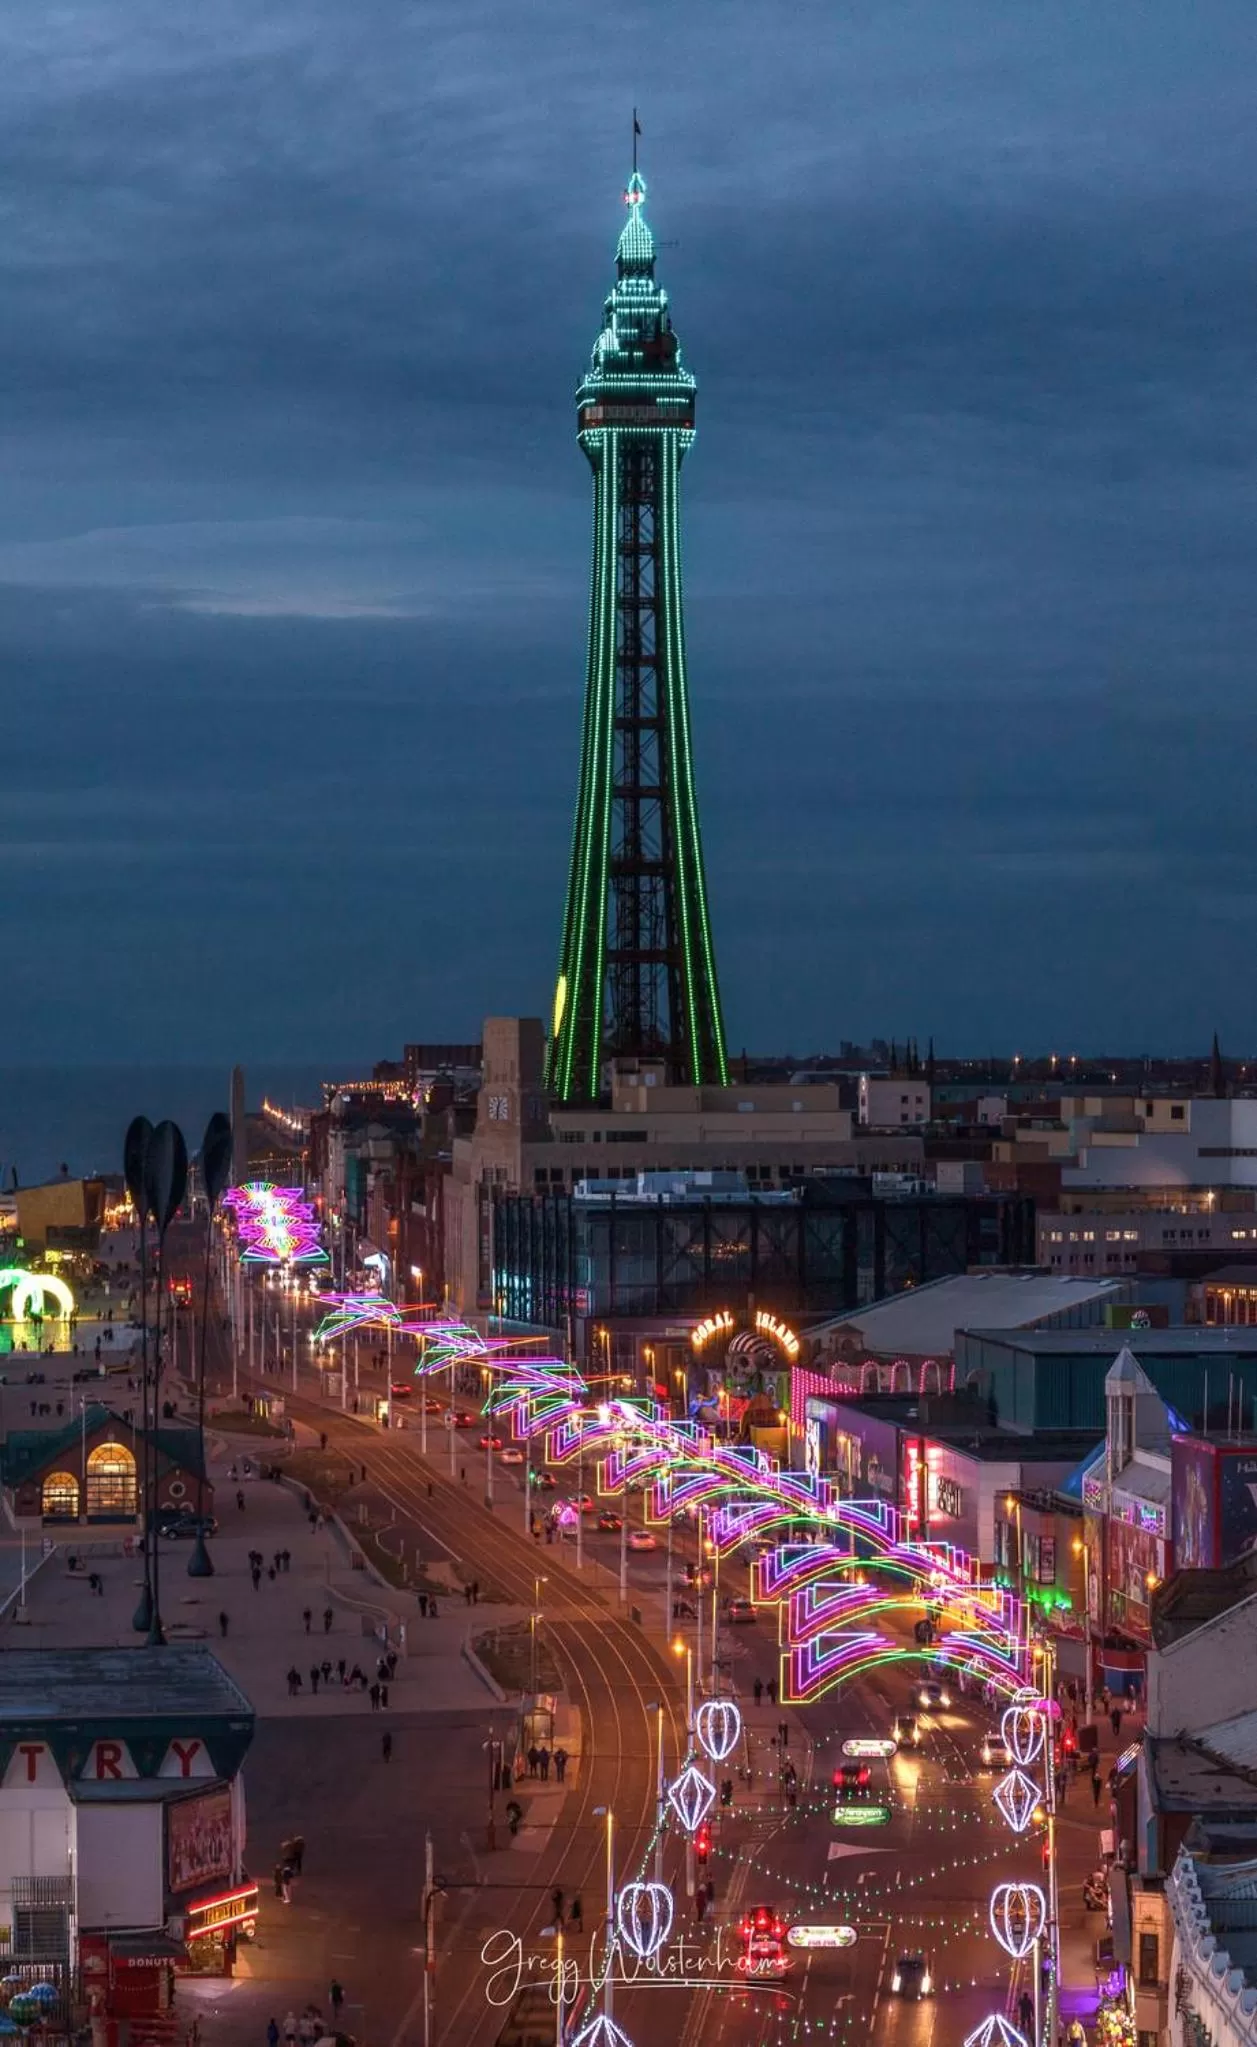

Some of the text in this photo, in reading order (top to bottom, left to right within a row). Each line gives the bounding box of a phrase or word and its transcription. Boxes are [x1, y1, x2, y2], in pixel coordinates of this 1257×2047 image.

[691, 1310, 800, 1353] CORAL ISLAND
[127, 1956, 176, 1968] DONUTS
